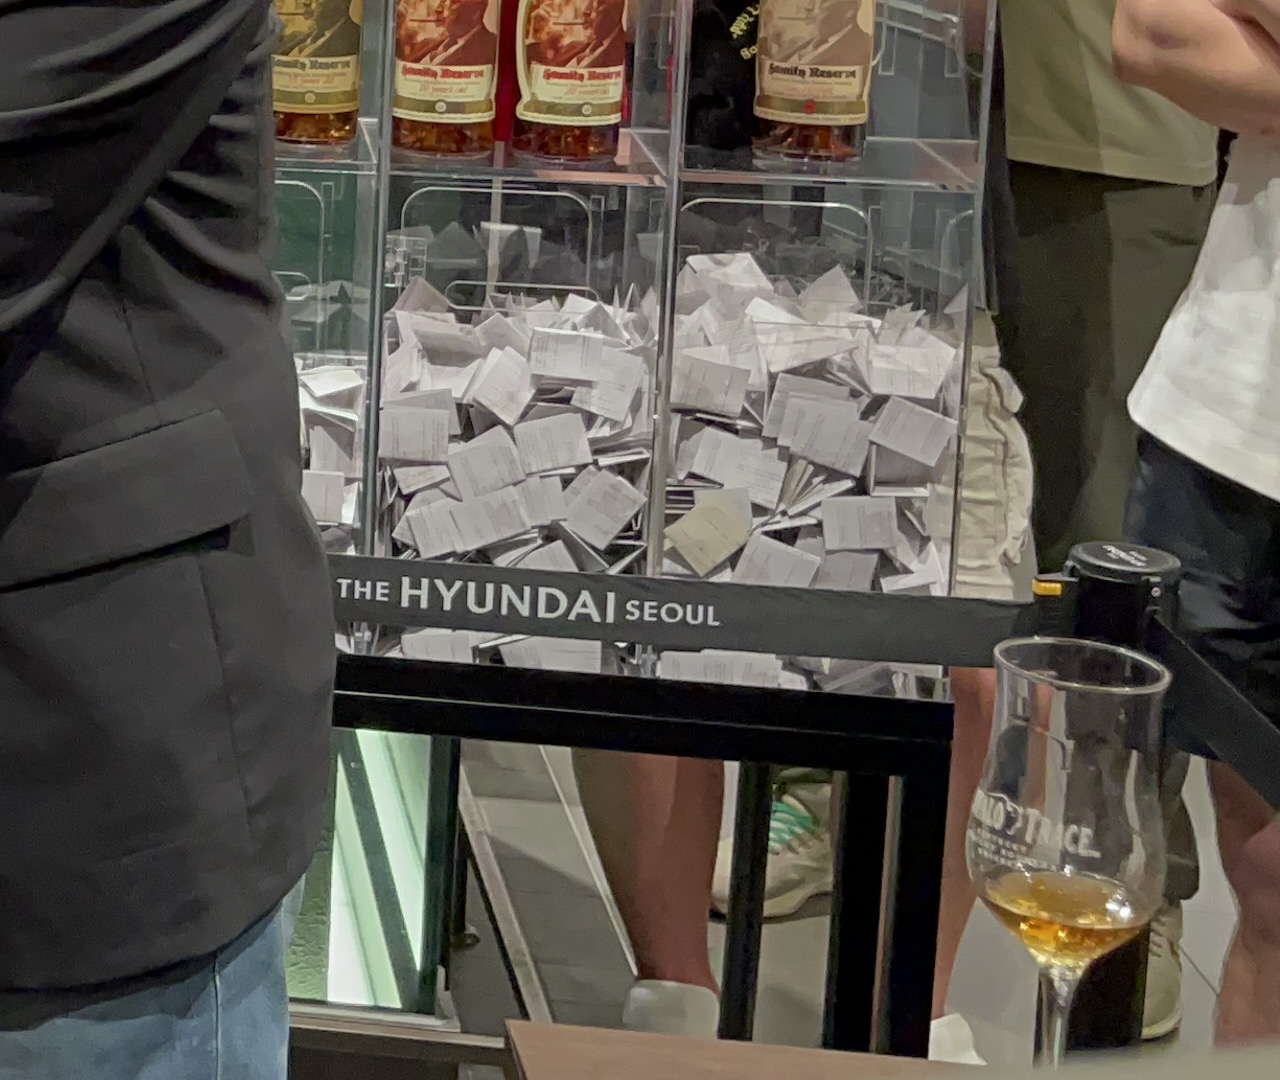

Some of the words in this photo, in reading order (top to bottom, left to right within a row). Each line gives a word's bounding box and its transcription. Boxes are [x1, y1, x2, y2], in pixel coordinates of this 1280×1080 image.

[336, 577, 390, 602] THE
[400, 575, 615, 624] HYUNDAI
[625, 599, 722, 627] SEOUL
